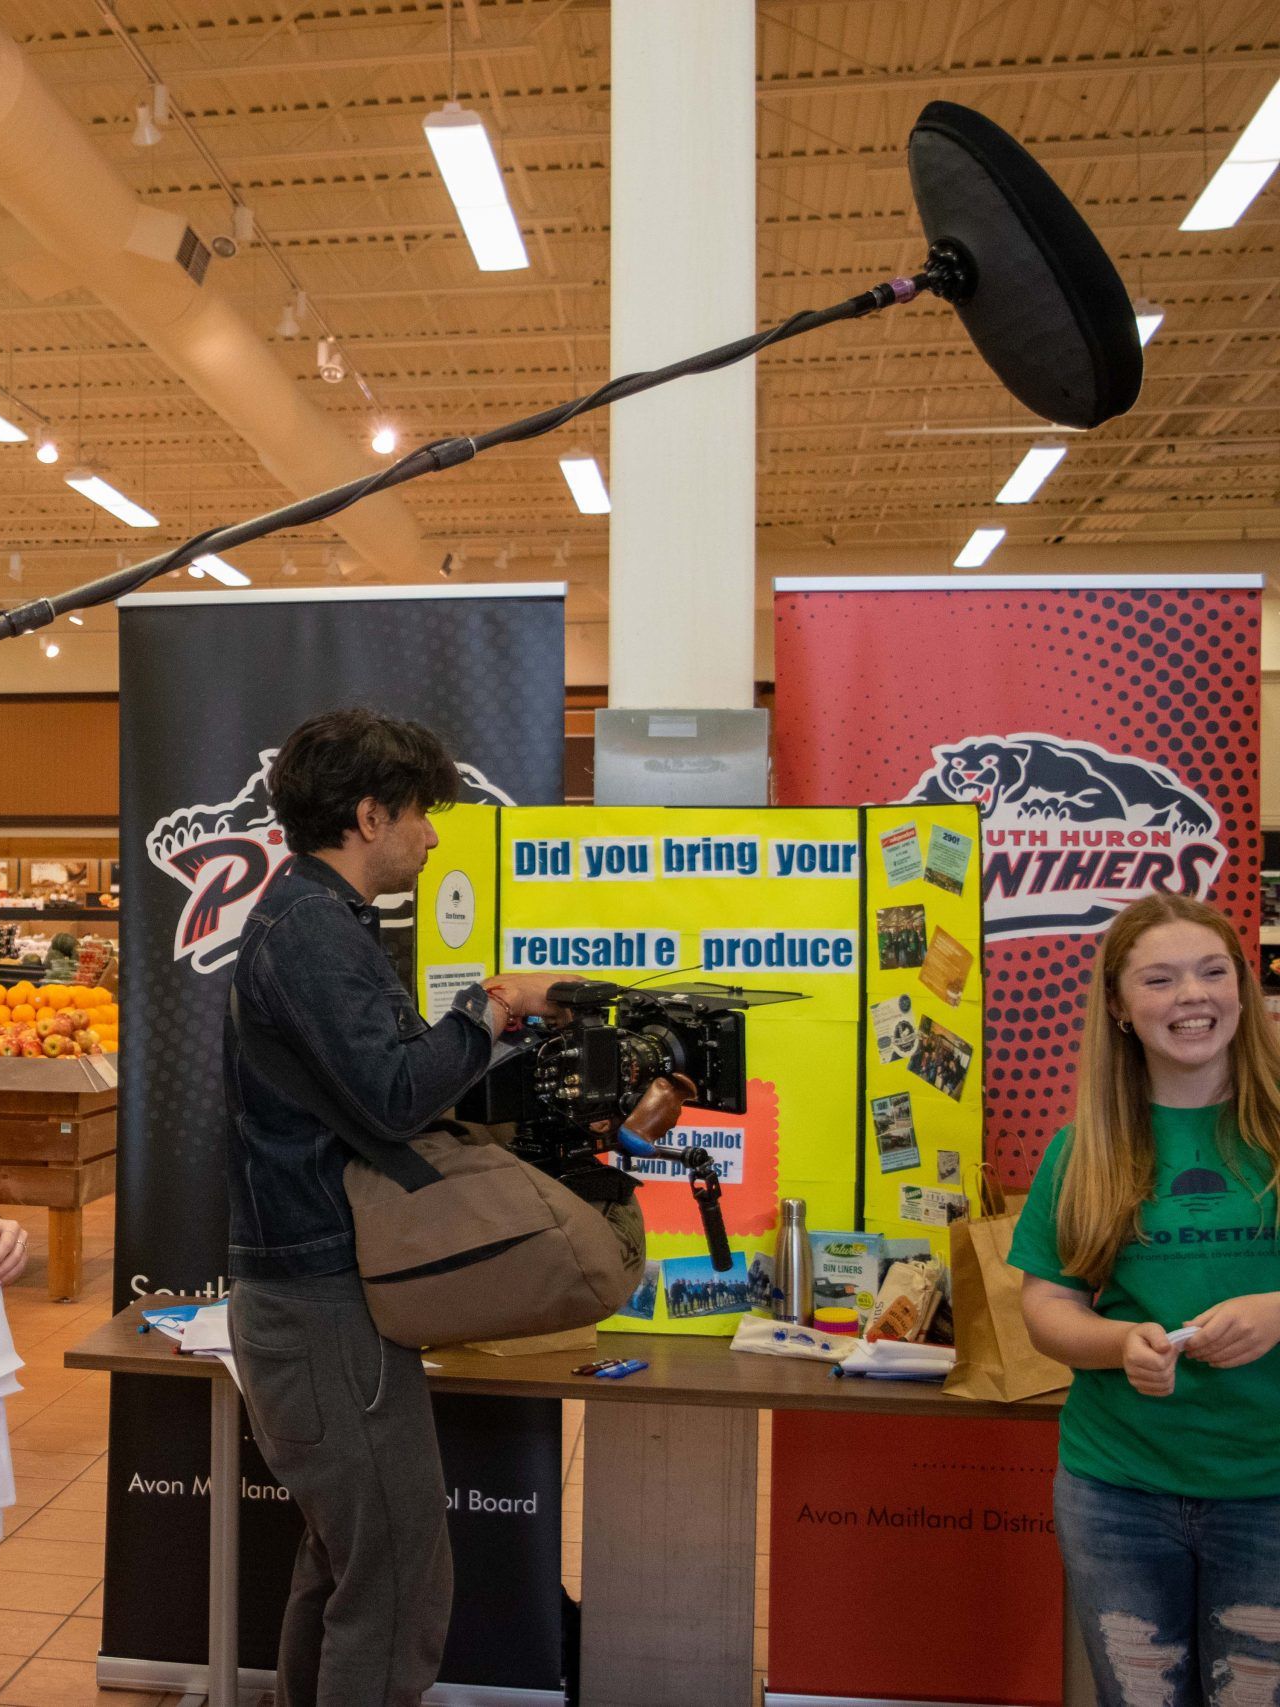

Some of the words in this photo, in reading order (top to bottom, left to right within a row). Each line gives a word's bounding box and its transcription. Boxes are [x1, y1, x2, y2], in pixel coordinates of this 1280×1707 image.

[986, 830, 1048, 847] UTH
[1061, 830, 1171, 848] HURON
[514, 841, 571, 877] Did
[585, 844, 649, 879] you
[663, 838, 758, 877] bring
[776, 843, 857, 877] your
[984, 842, 1219, 902] NTHERS
[512, 932, 675, 968] reusable
[703, 932, 853, 971] produce
[657, 1130, 674, 1146] ut
[677, 1132, 688, 1147] a
[692, 1130, 742, 1149] ballot
[637, 1159, 667, 1175] win
[671, 1160, 734, 1178] prs!
[823, 1263, 836, 1273] BIN
[837, 1264, 863, 1275] LINERS
[1136, 1254, 1161, 1262] from
[128, 1472, 185, 1496] Avon
[192, 1476, 290, 1501] Mland
[469, 1489, 538, 1514] Board
[797, 1503, 858, 1527] Avon
[866, 1506, 974, 1531] Maitland
[983, 1509, 1055, 1534] Distric
